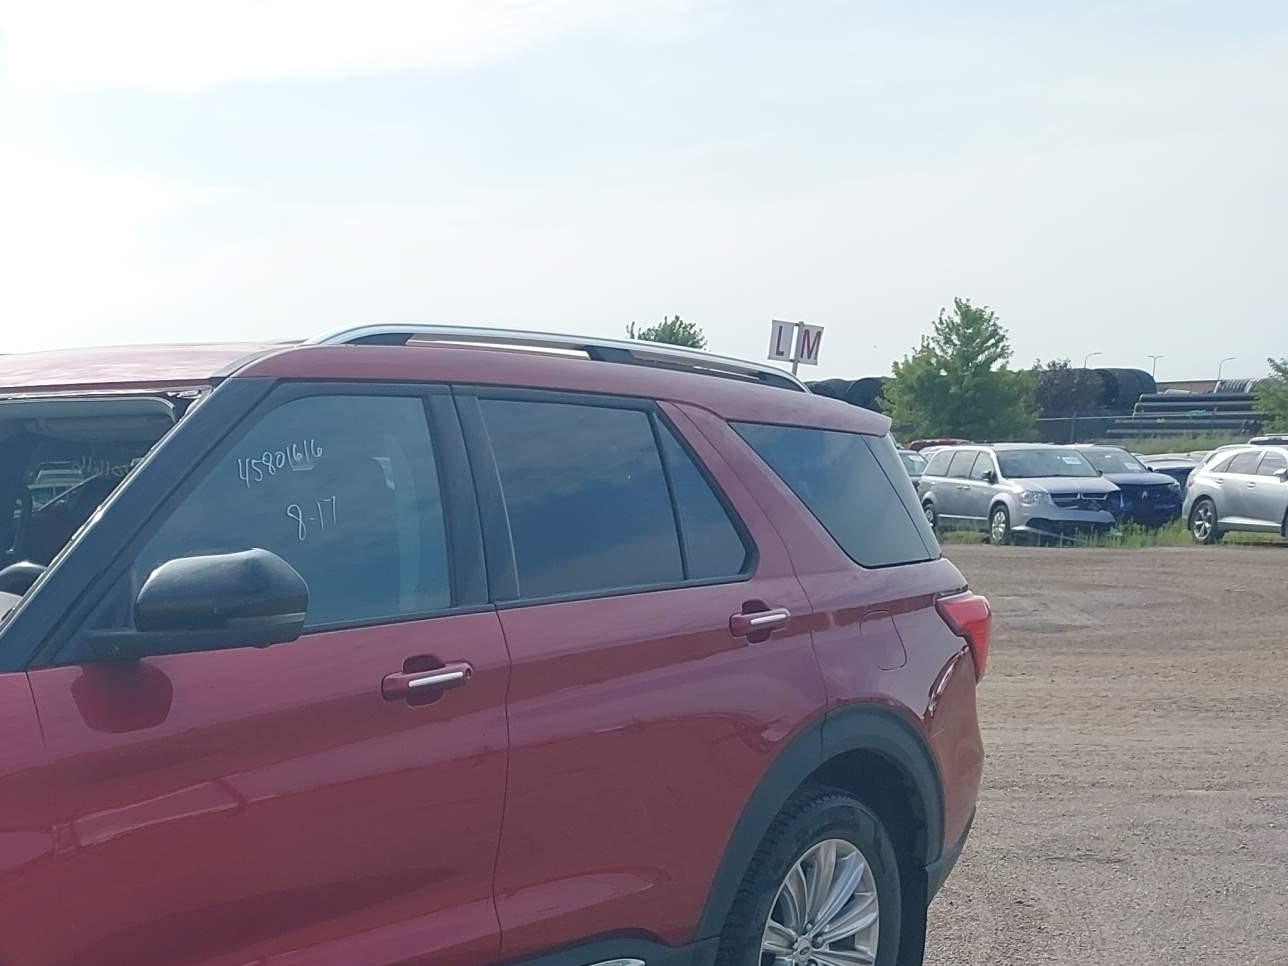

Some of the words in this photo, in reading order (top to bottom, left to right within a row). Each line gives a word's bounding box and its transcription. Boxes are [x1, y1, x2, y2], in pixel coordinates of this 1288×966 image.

[776, 325, 785, 356] L
[800, 329, 822, 360] M
[237, 439, 323, 489] 45801616
[286, 495, 337, 541] 8-17
